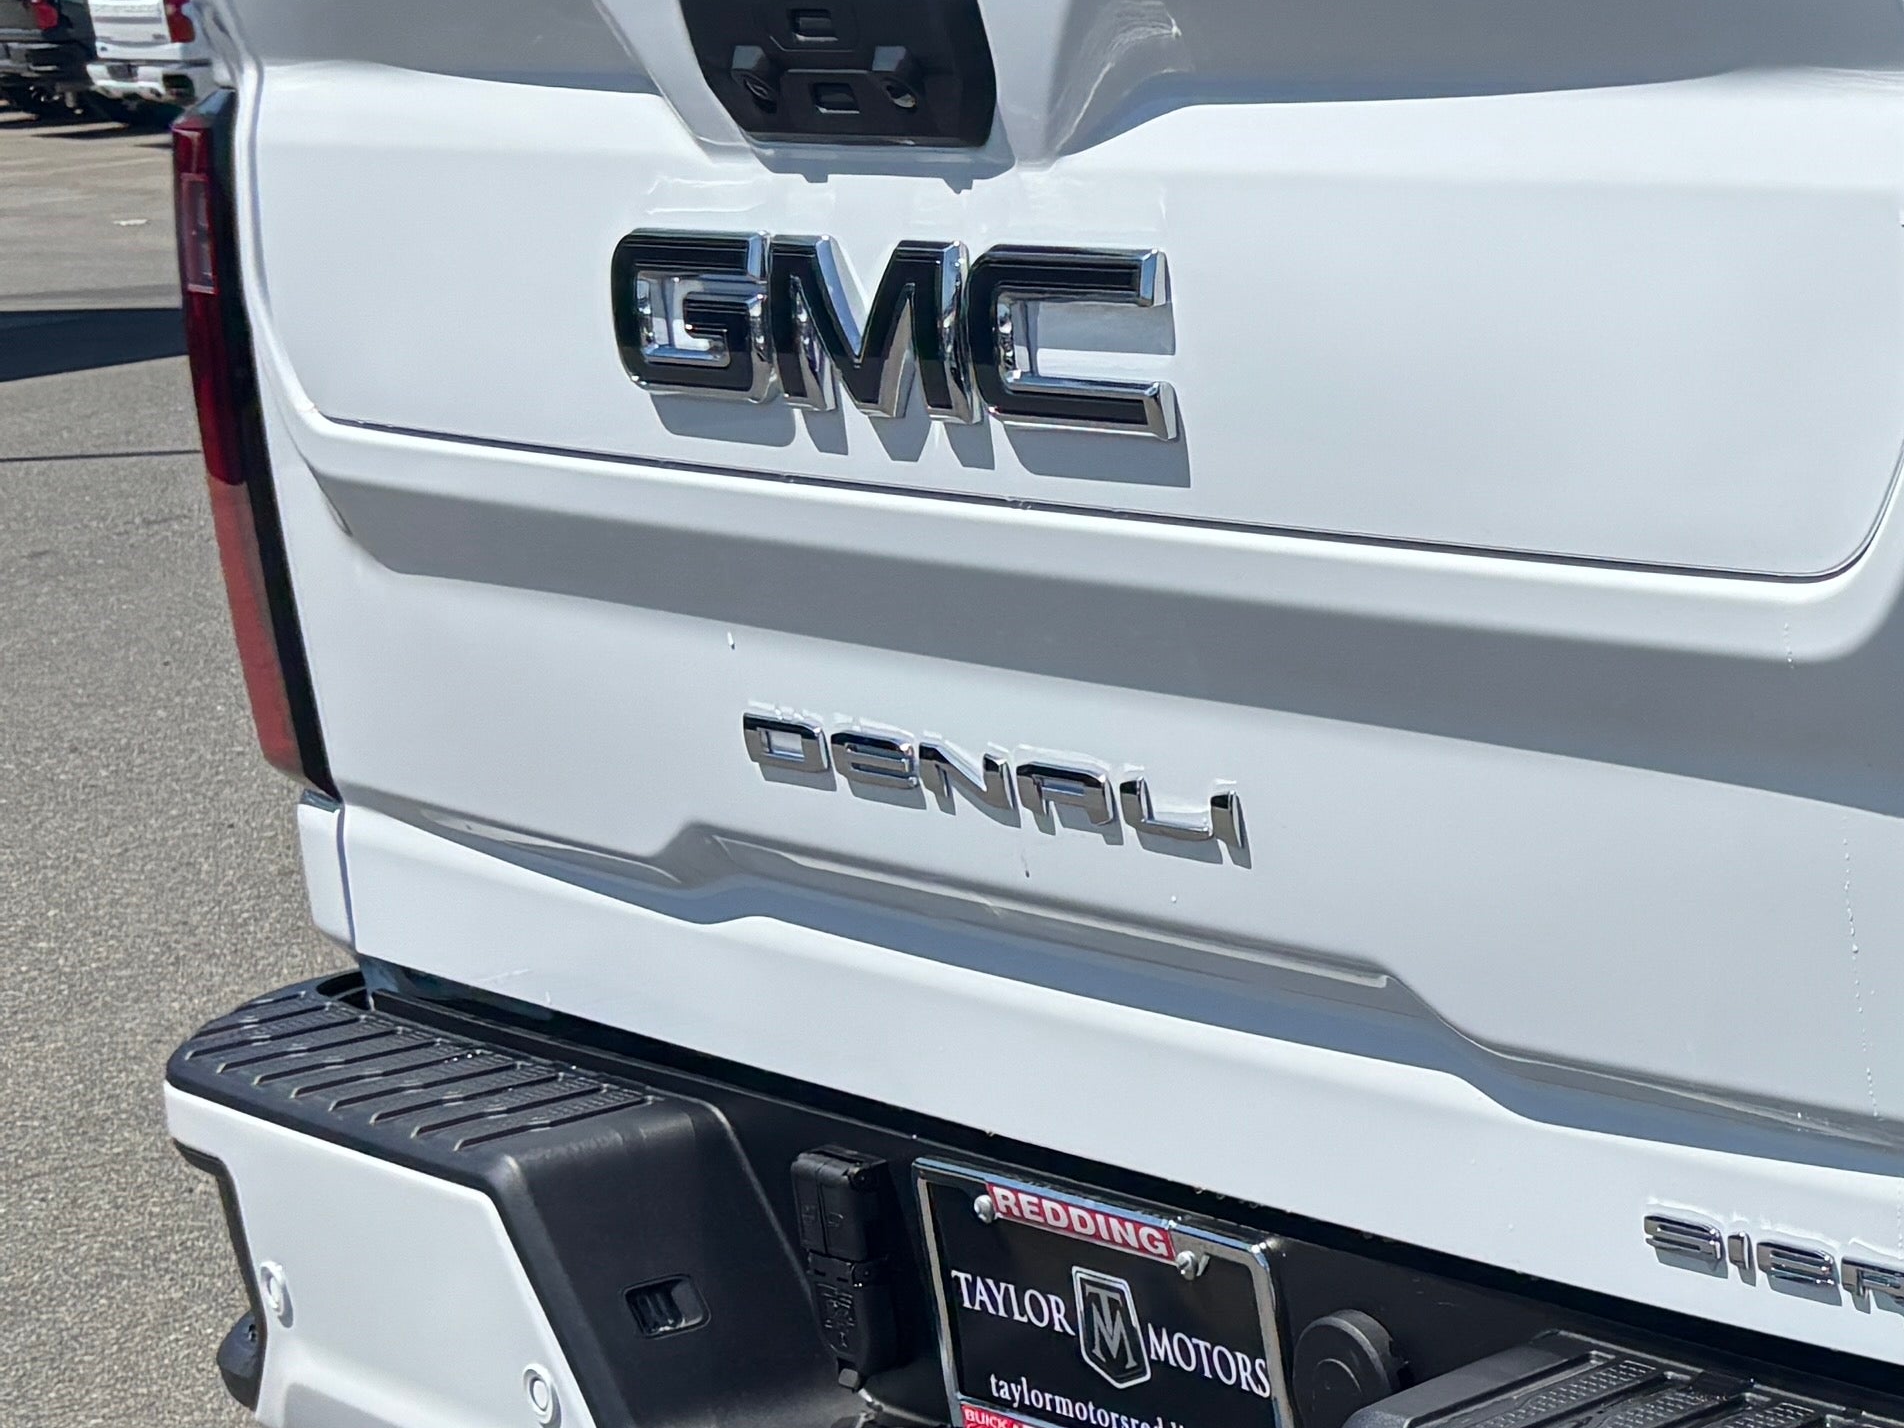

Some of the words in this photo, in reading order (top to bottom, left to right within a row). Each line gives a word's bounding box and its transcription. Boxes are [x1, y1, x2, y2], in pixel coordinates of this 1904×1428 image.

[611, 228, 1178, 441] GMC
[743, 711, 1249, 850] DENALI
[992, 1186, 1169, 1258] REDDING
[951, 1269, 1076, 1337] TAYLOR
[1147, 1323, 1271, 1399] MOTORS
